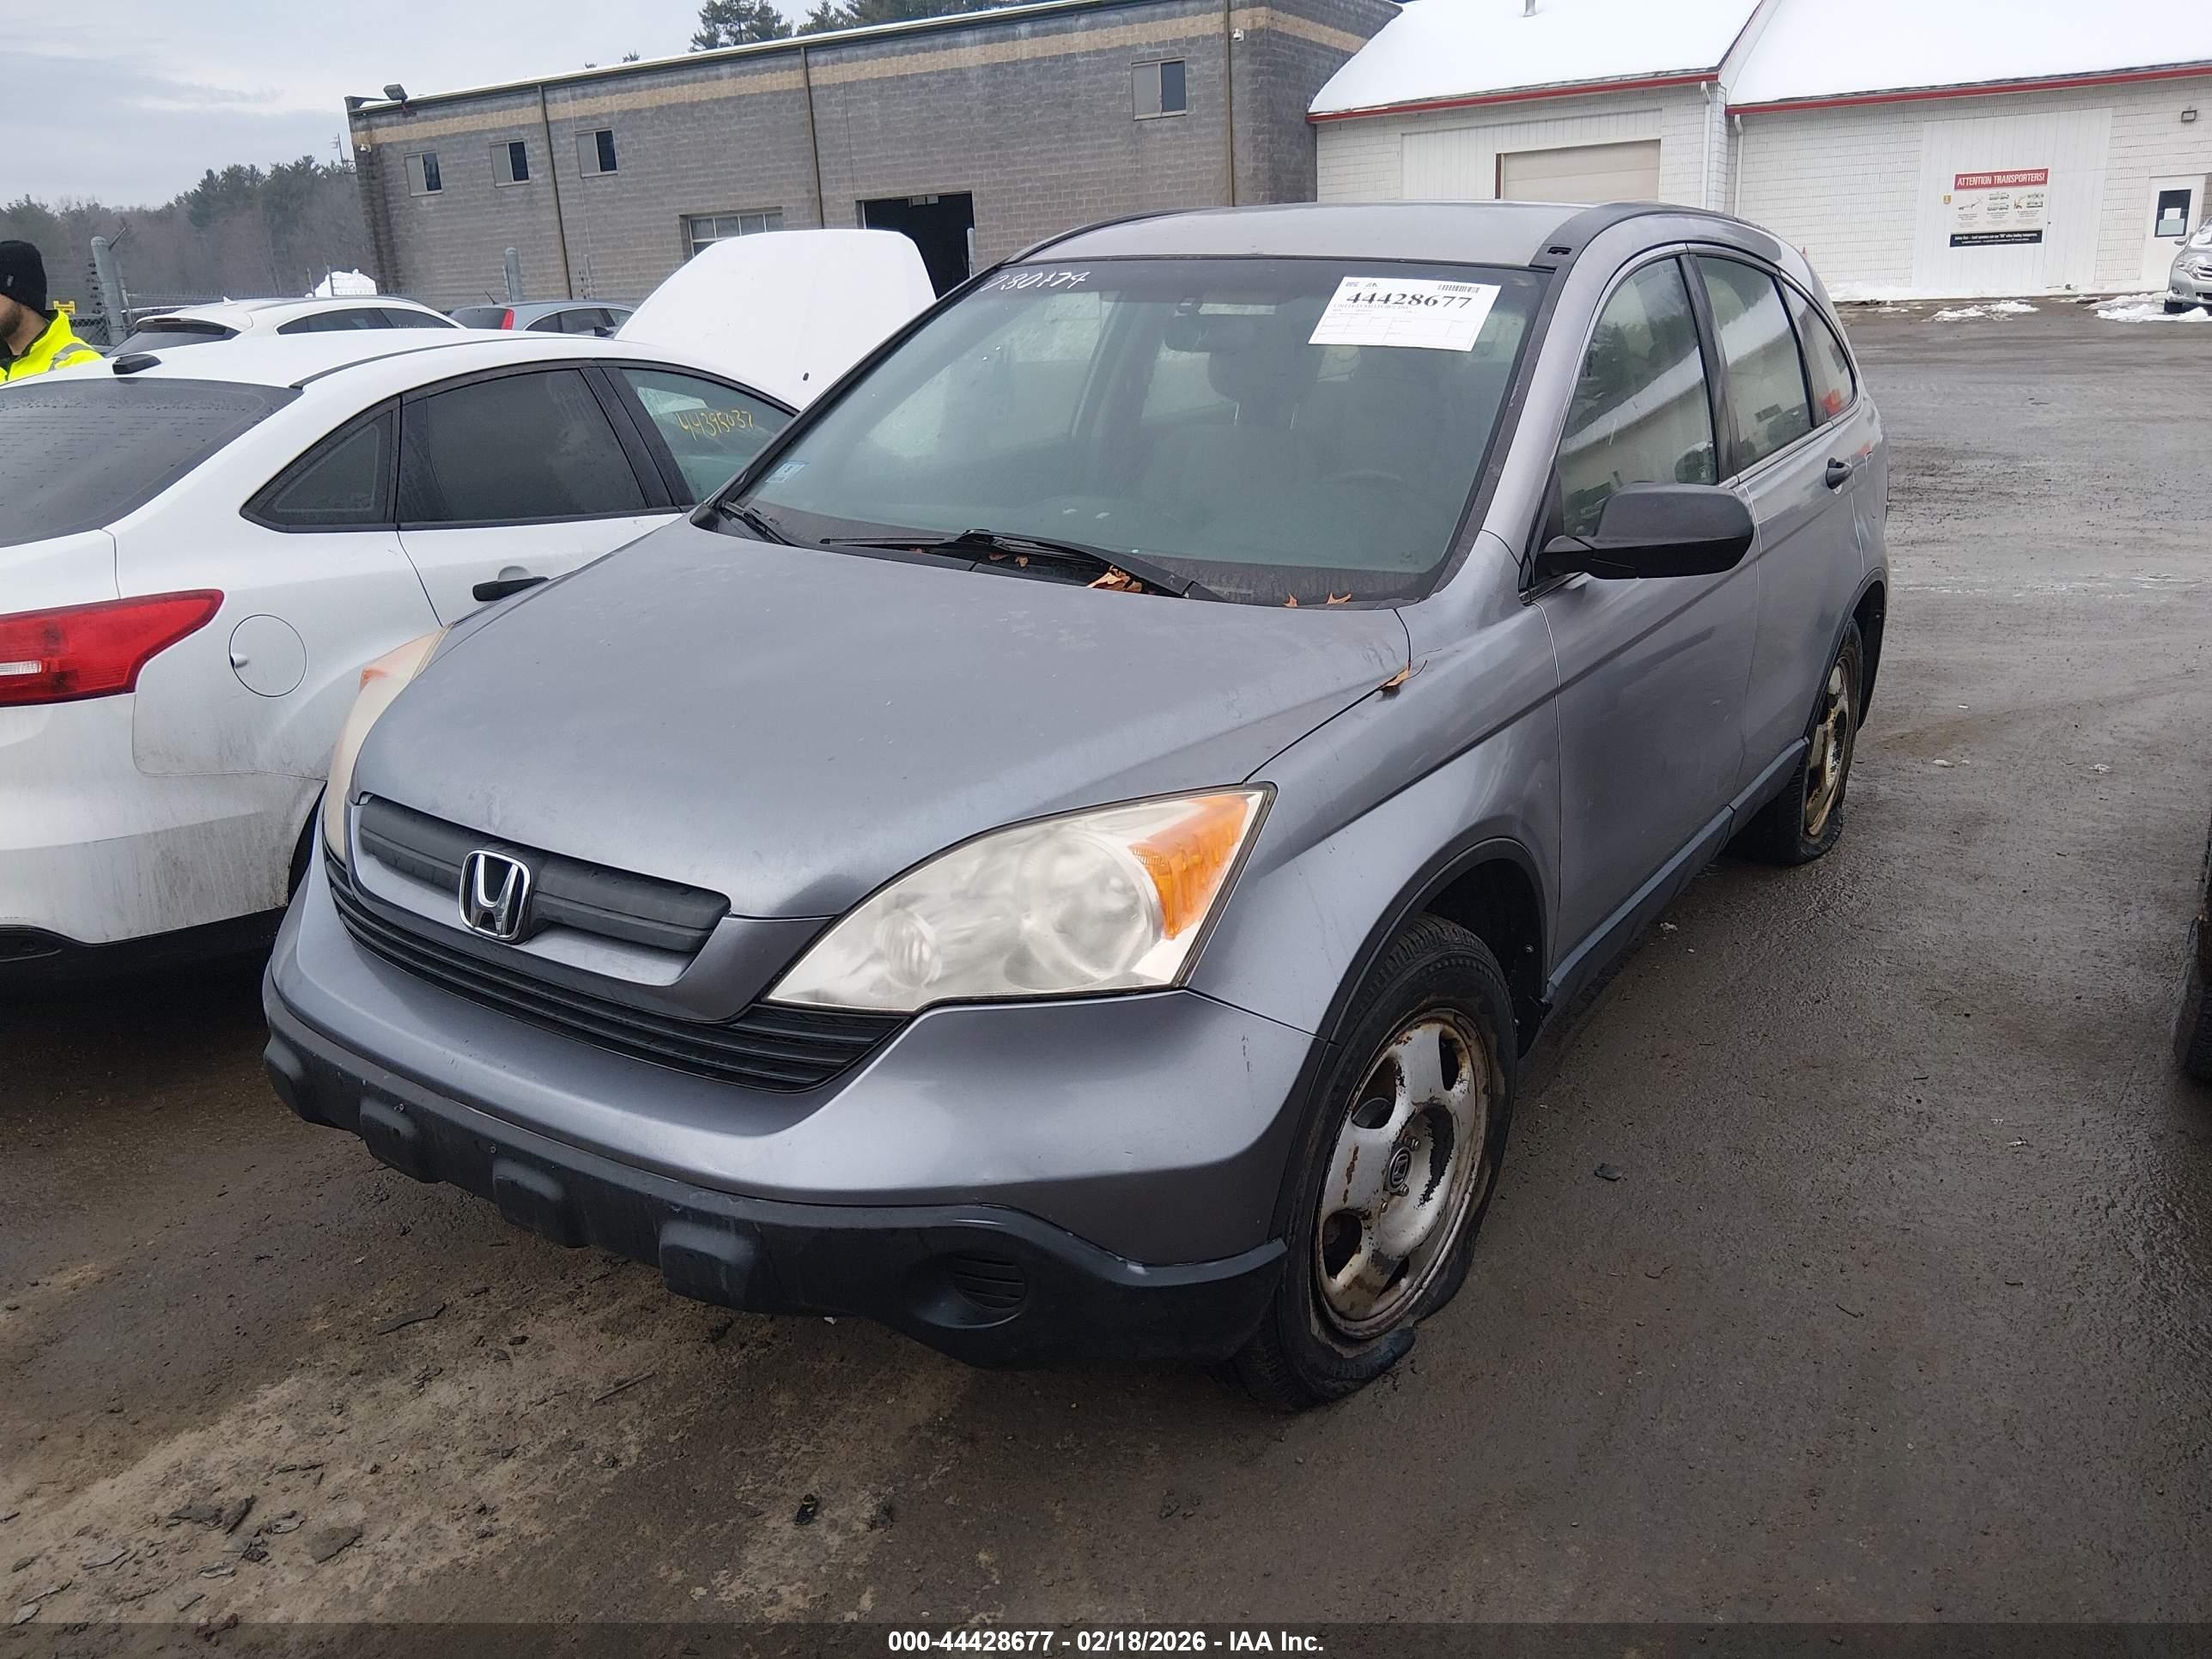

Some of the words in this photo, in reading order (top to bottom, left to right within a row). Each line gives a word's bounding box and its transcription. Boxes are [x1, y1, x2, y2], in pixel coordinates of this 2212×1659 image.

[1957, 176, 1992, 186] ATTENTION
[1994, 173, 2045, 185] TRANSPORTERS!
[1346, 292, 1473, 309] 44428677
[674, 410, 754, 441] 44395037
